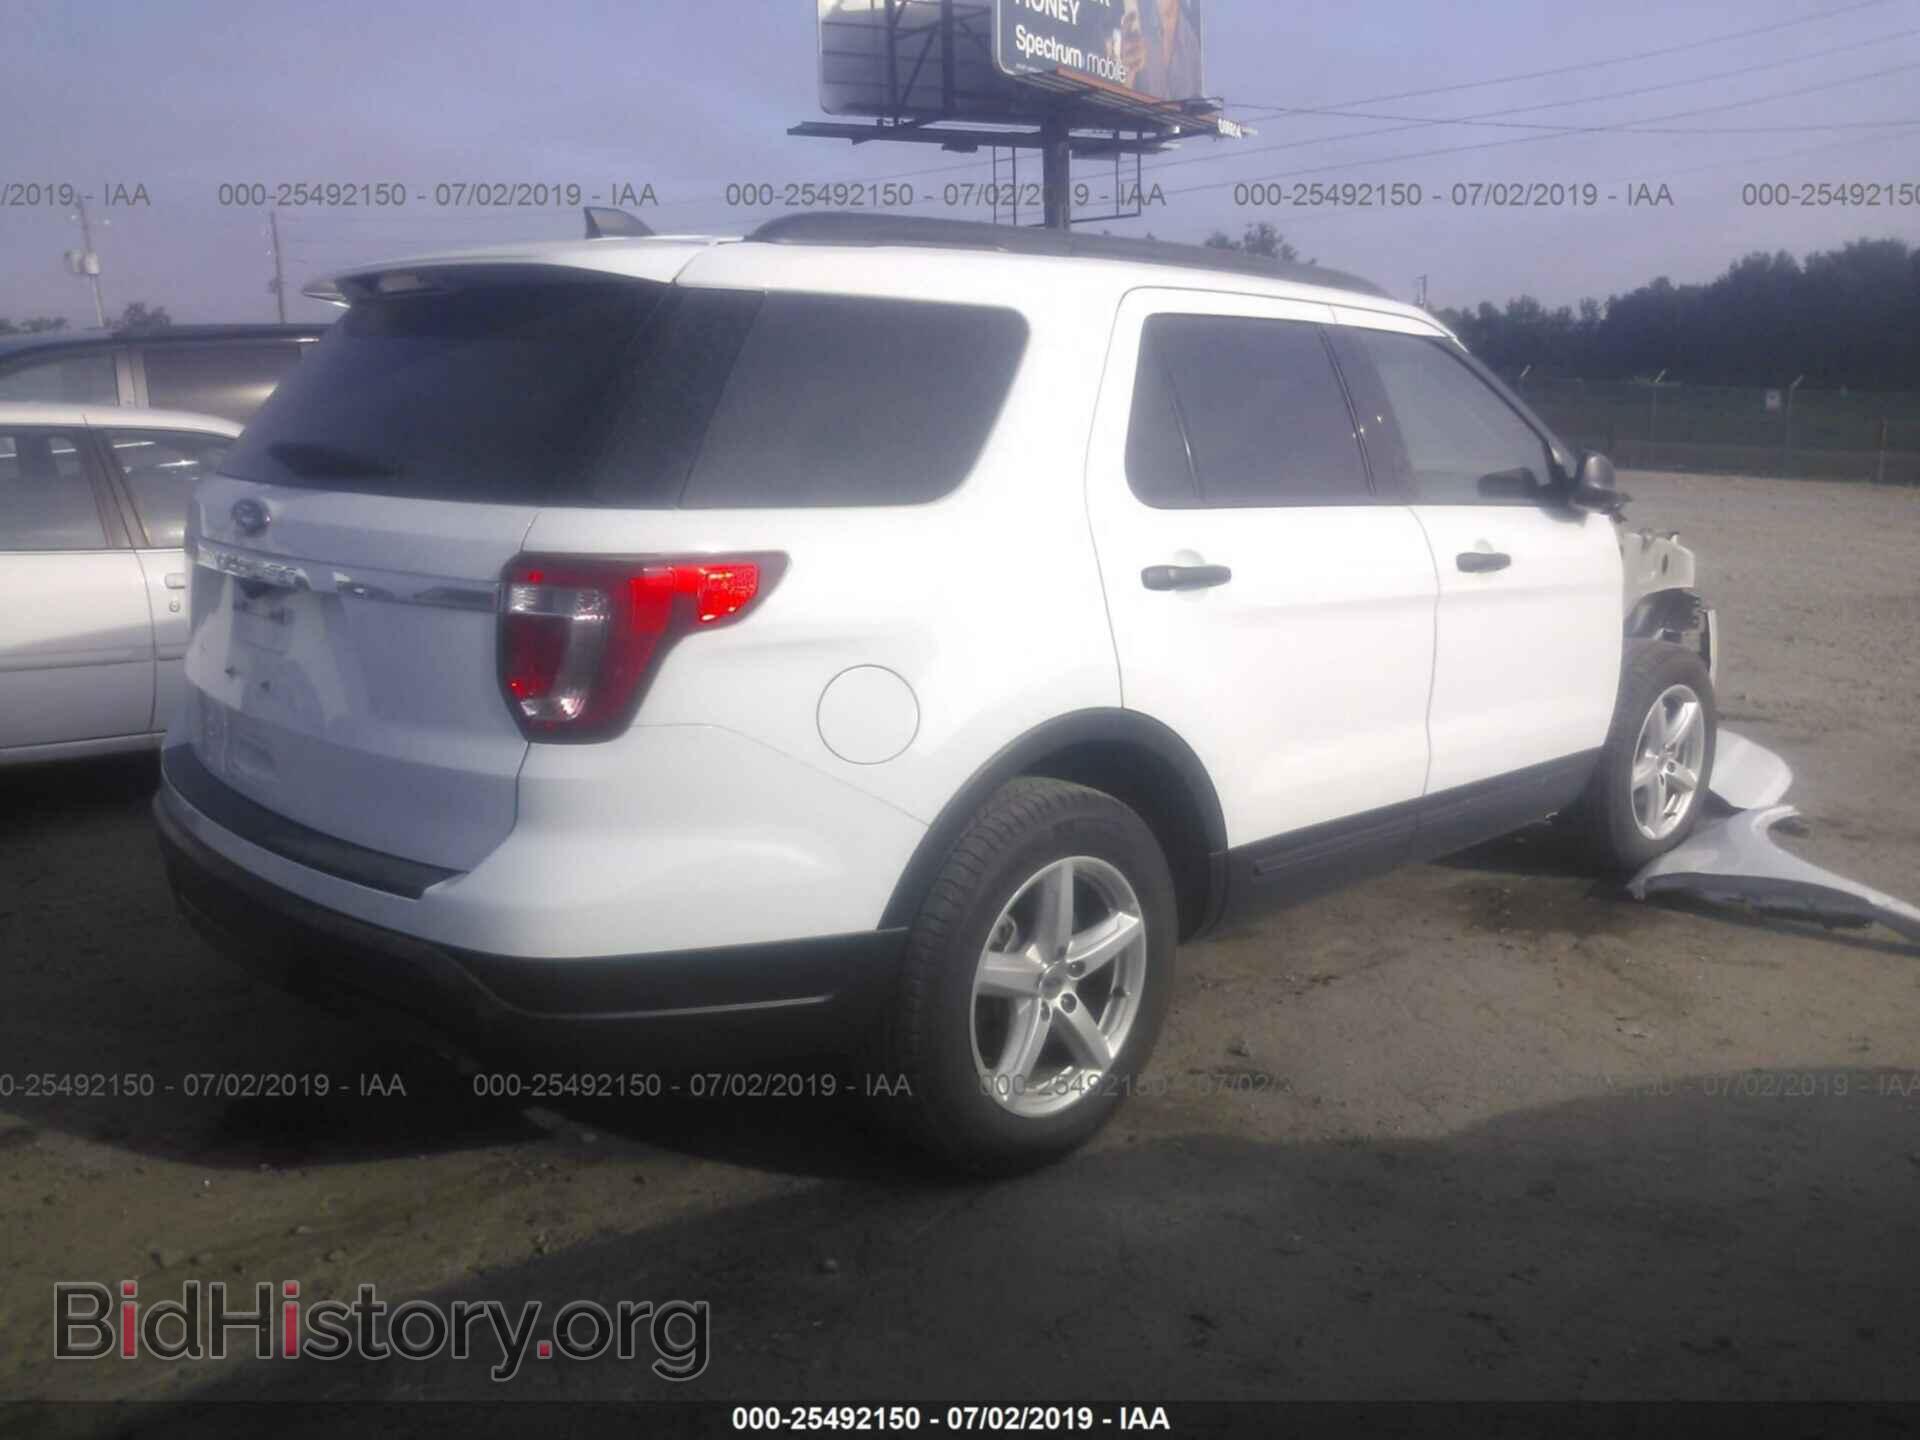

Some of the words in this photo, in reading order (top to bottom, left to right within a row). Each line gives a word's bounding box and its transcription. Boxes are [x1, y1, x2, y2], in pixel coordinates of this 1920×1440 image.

[1015, 0, 1081, 25] ONEY
[1015, 23, 1083, 69] Spectrum
[1086, 52, 1128, 83] mobile
